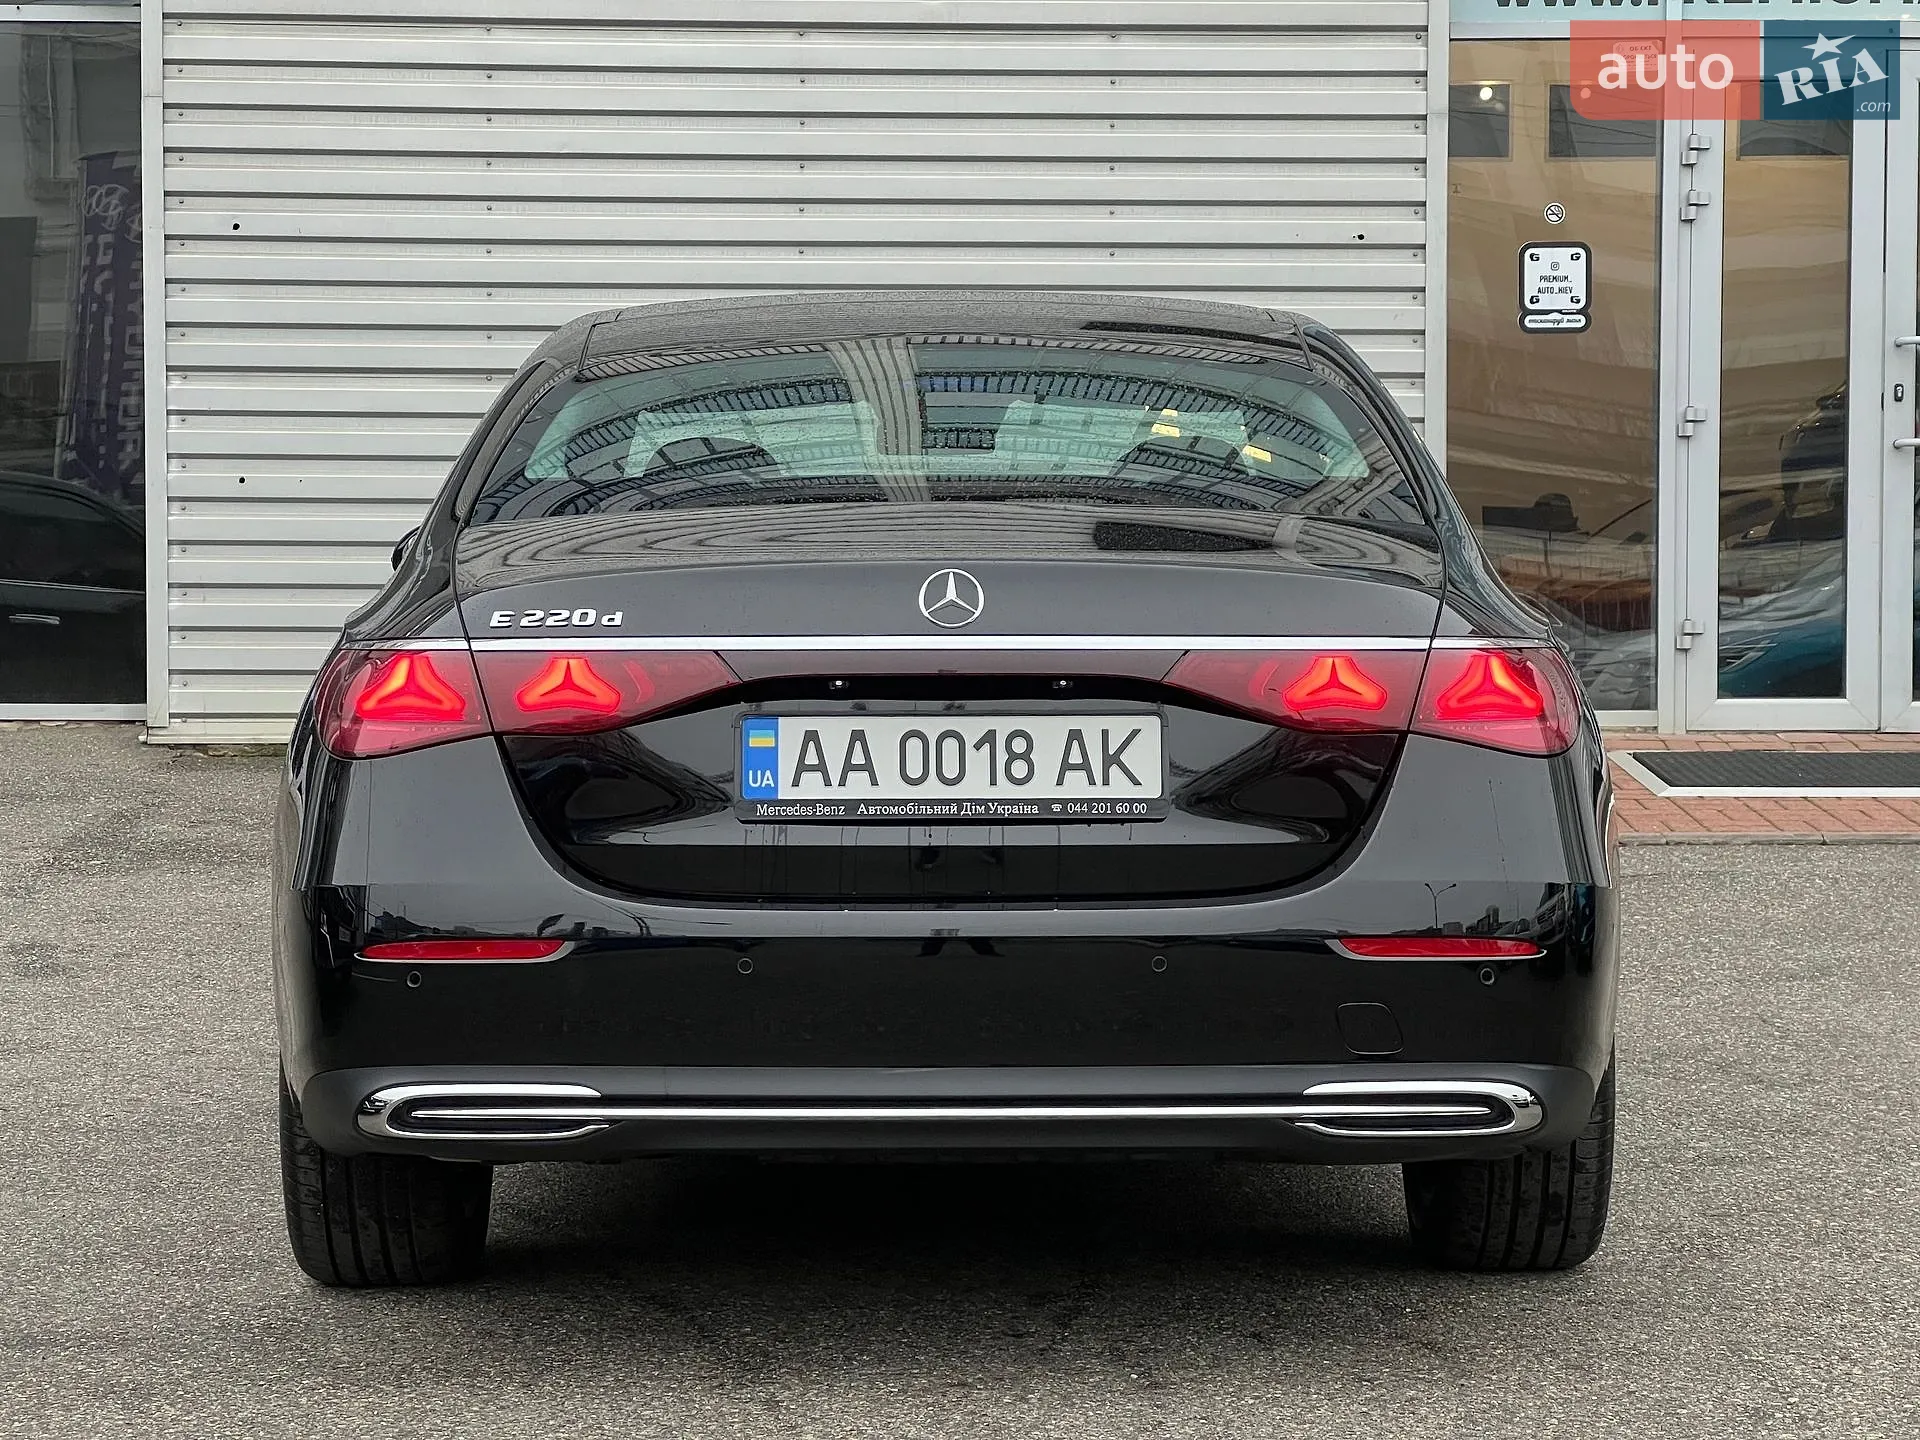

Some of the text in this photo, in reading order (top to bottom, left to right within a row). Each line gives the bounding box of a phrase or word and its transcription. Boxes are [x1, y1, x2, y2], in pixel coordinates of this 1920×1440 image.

[489, 608, 624, 628] E 220 d
[791, 728, 1143, 787] AA 0018 AK
[748, 771, 775, 788] UA
[756, 802, 1147, 817] Mercedes-Benz Автомобільний Дім Україна 044 201 60 00
